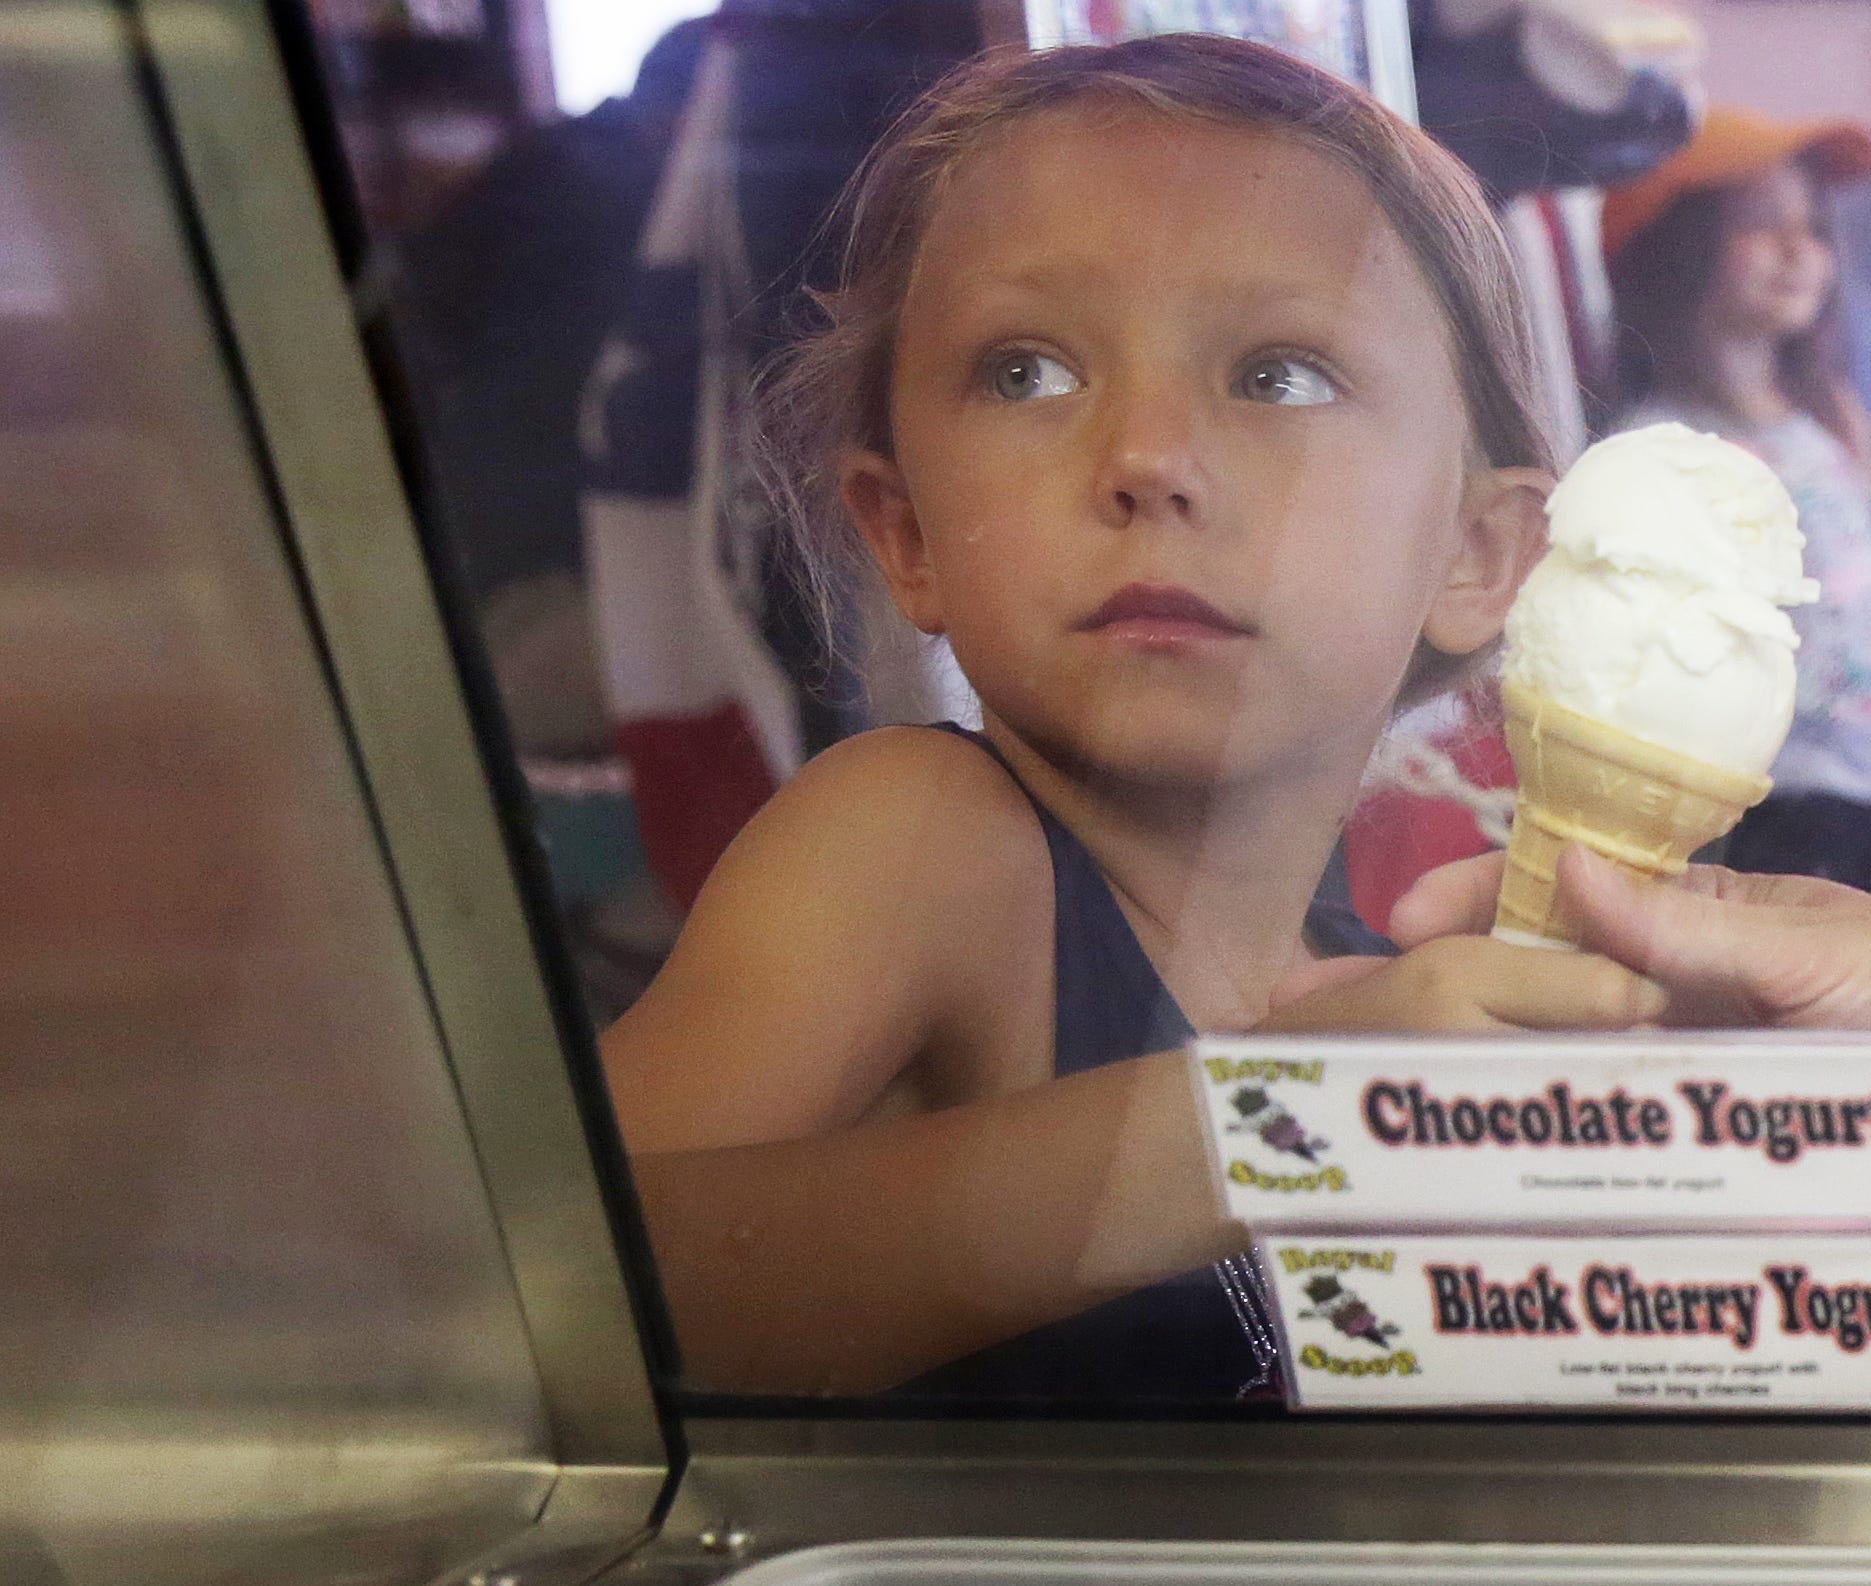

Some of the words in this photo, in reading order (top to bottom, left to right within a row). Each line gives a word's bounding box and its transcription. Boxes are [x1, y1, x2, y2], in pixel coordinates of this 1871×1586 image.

[1360, 1079, 1669, 1147] Chocolate
[1424, 1263, 1580, 1336] Black
[1580, 1262, 1761, 1351] Cherry
